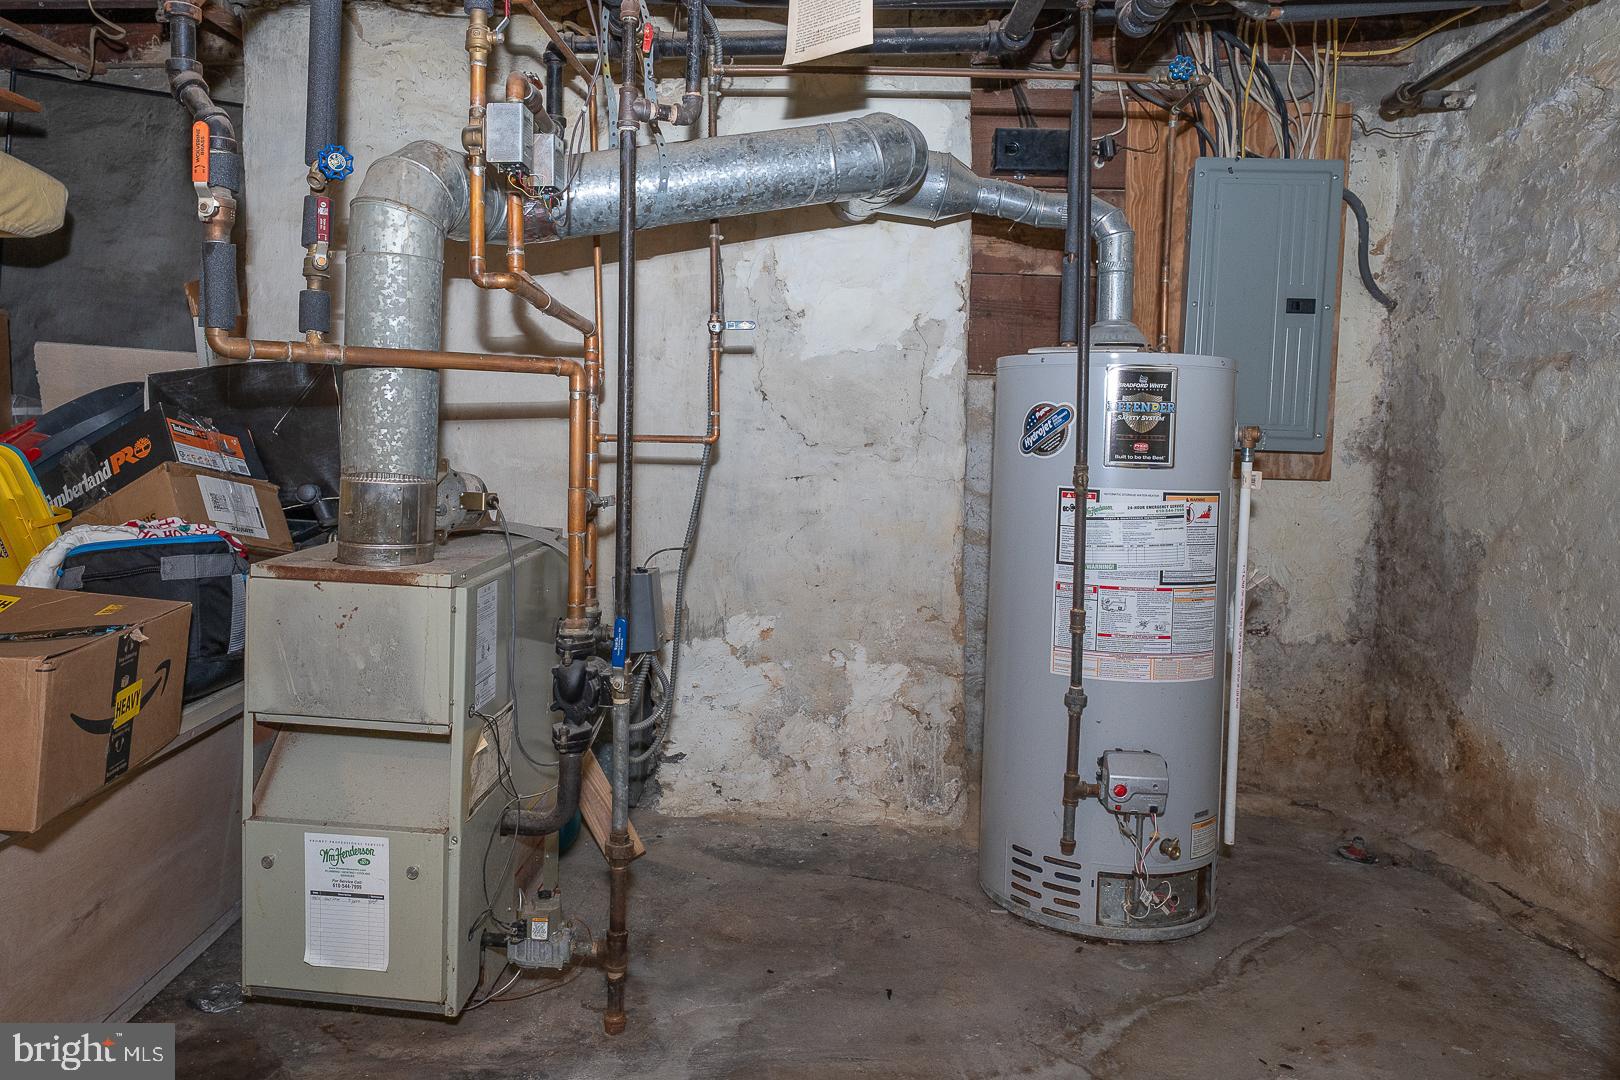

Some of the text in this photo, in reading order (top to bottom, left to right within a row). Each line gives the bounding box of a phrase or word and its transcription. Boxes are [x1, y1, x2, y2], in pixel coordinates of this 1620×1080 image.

[1107, 401, 1176, 413] EFENDER
[1024, 418, 1053, 448] Hydrojet
[46, 459, 113, 508] imberland
[115, 689, 141, 717] HEAVY
[331, 845, 375, 866] Henderson
